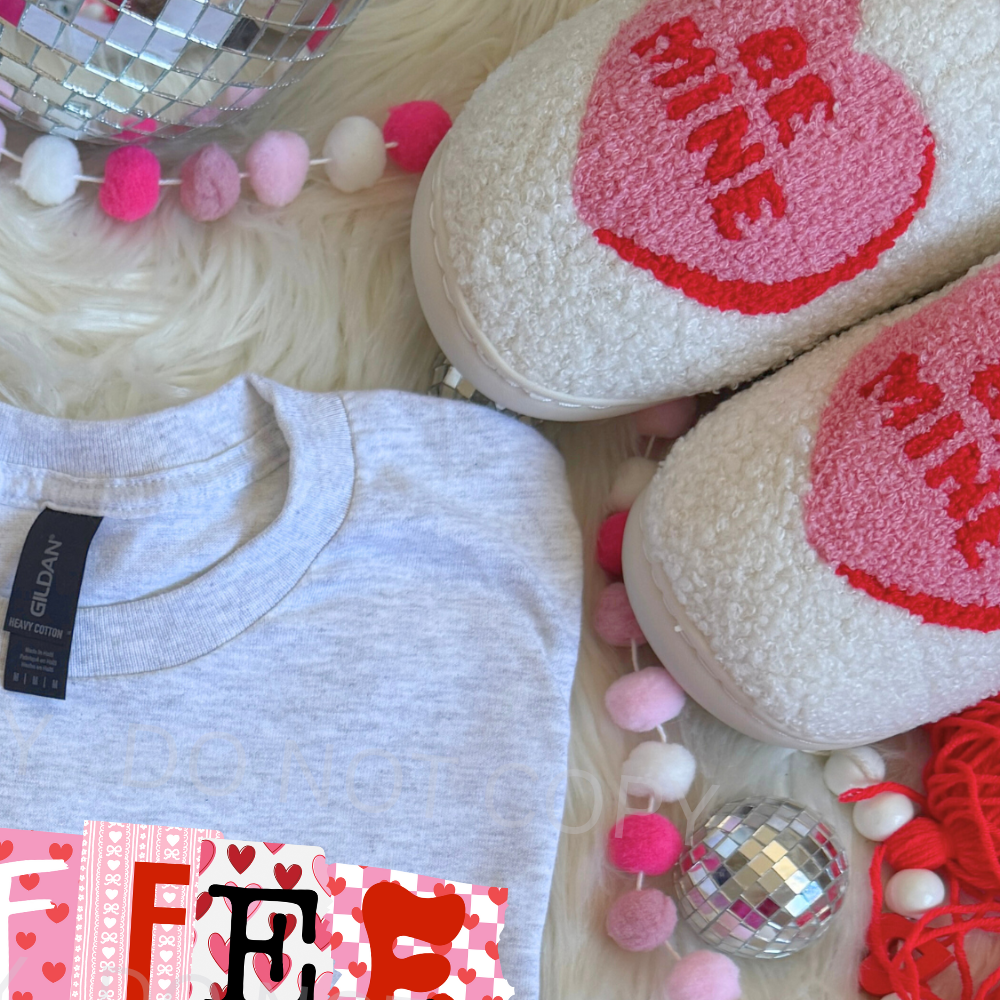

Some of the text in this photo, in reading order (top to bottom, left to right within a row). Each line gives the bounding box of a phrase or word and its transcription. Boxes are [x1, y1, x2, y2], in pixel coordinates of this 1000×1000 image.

[630, 16, 788, 241] MINE
[737, 26, 836, 148] BE
[9, 616, 64, 640] HEAVY COTTON
[30, 539, 63, 617] GILDAN
